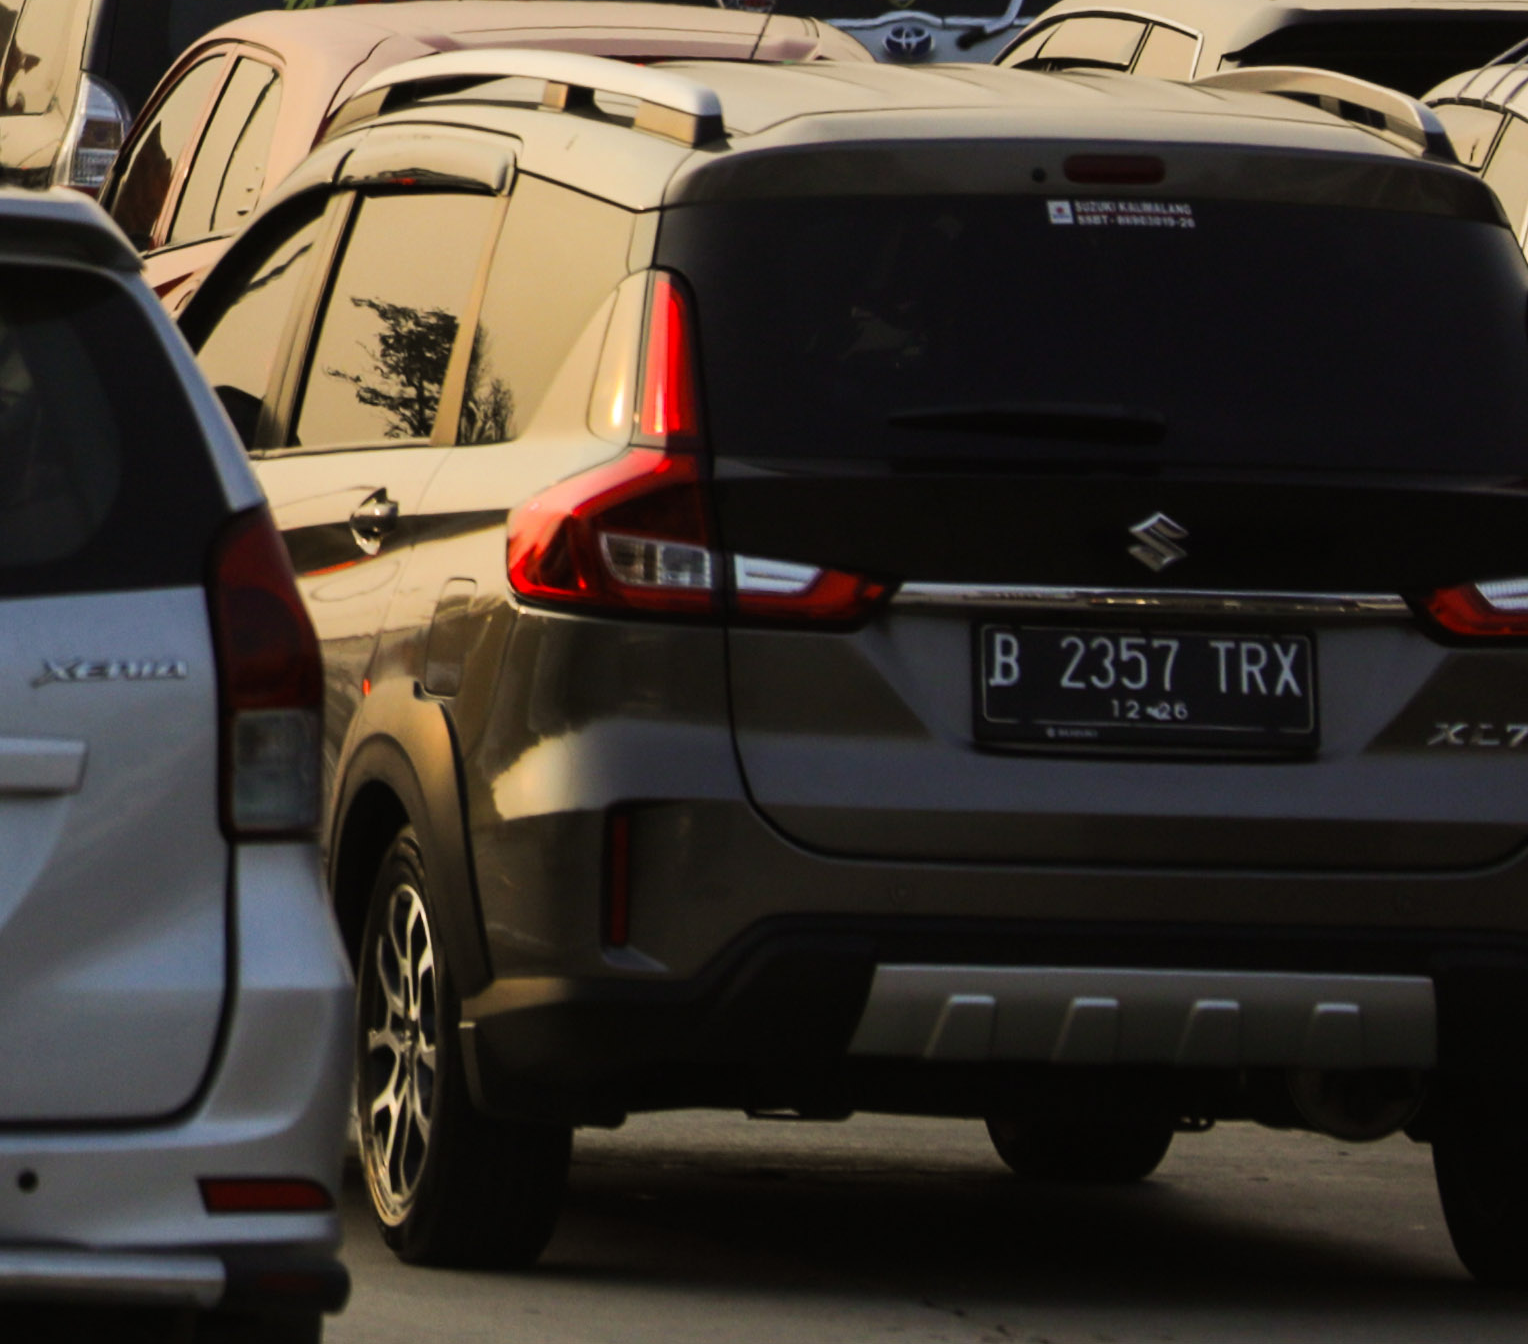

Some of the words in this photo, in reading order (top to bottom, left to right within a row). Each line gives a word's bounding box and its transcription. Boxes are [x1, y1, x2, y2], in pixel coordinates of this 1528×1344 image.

[33, 654, 188, 688] XENIA
[989, 632, 1022, 688] B
[1058, 635, 1181, 693] 2357
[1209, 639, 1303, 698] TRX
